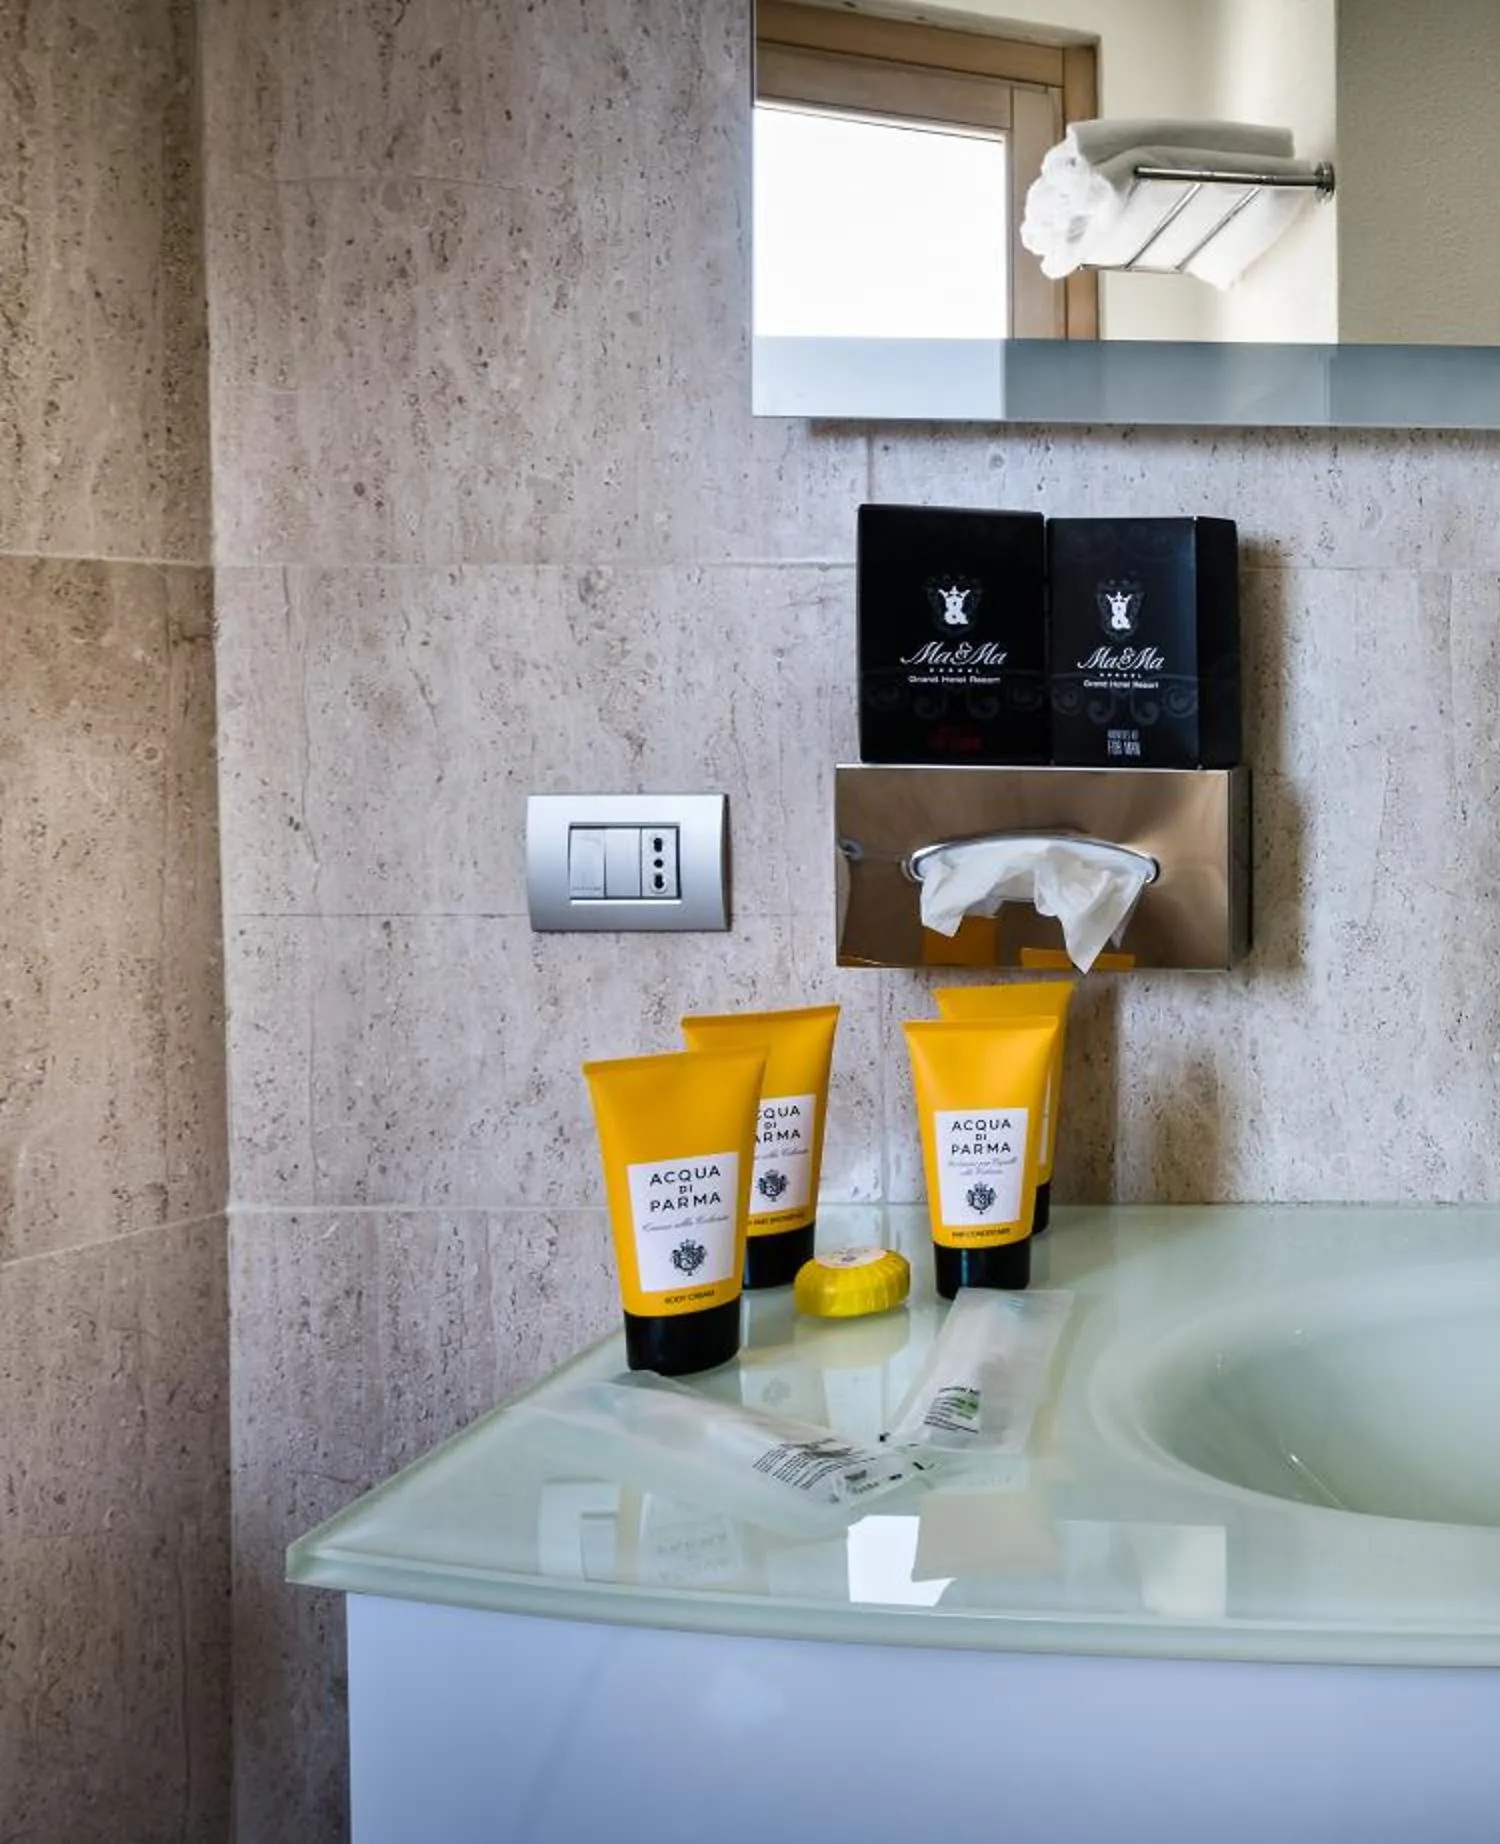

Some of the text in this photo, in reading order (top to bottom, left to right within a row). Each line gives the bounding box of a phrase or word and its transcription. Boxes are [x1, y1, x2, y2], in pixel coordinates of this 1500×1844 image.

[951, 1119, 1012, 1132] ACQUA
[975, 1133, 987, 1141] DI
[951, 1142, 1012, 1155] PARMA
[649, 1165, 721, 1187] ACQUA
[678, 1184, 693, 1195] DI
[649, 1191, 722, 1213] PARMA
